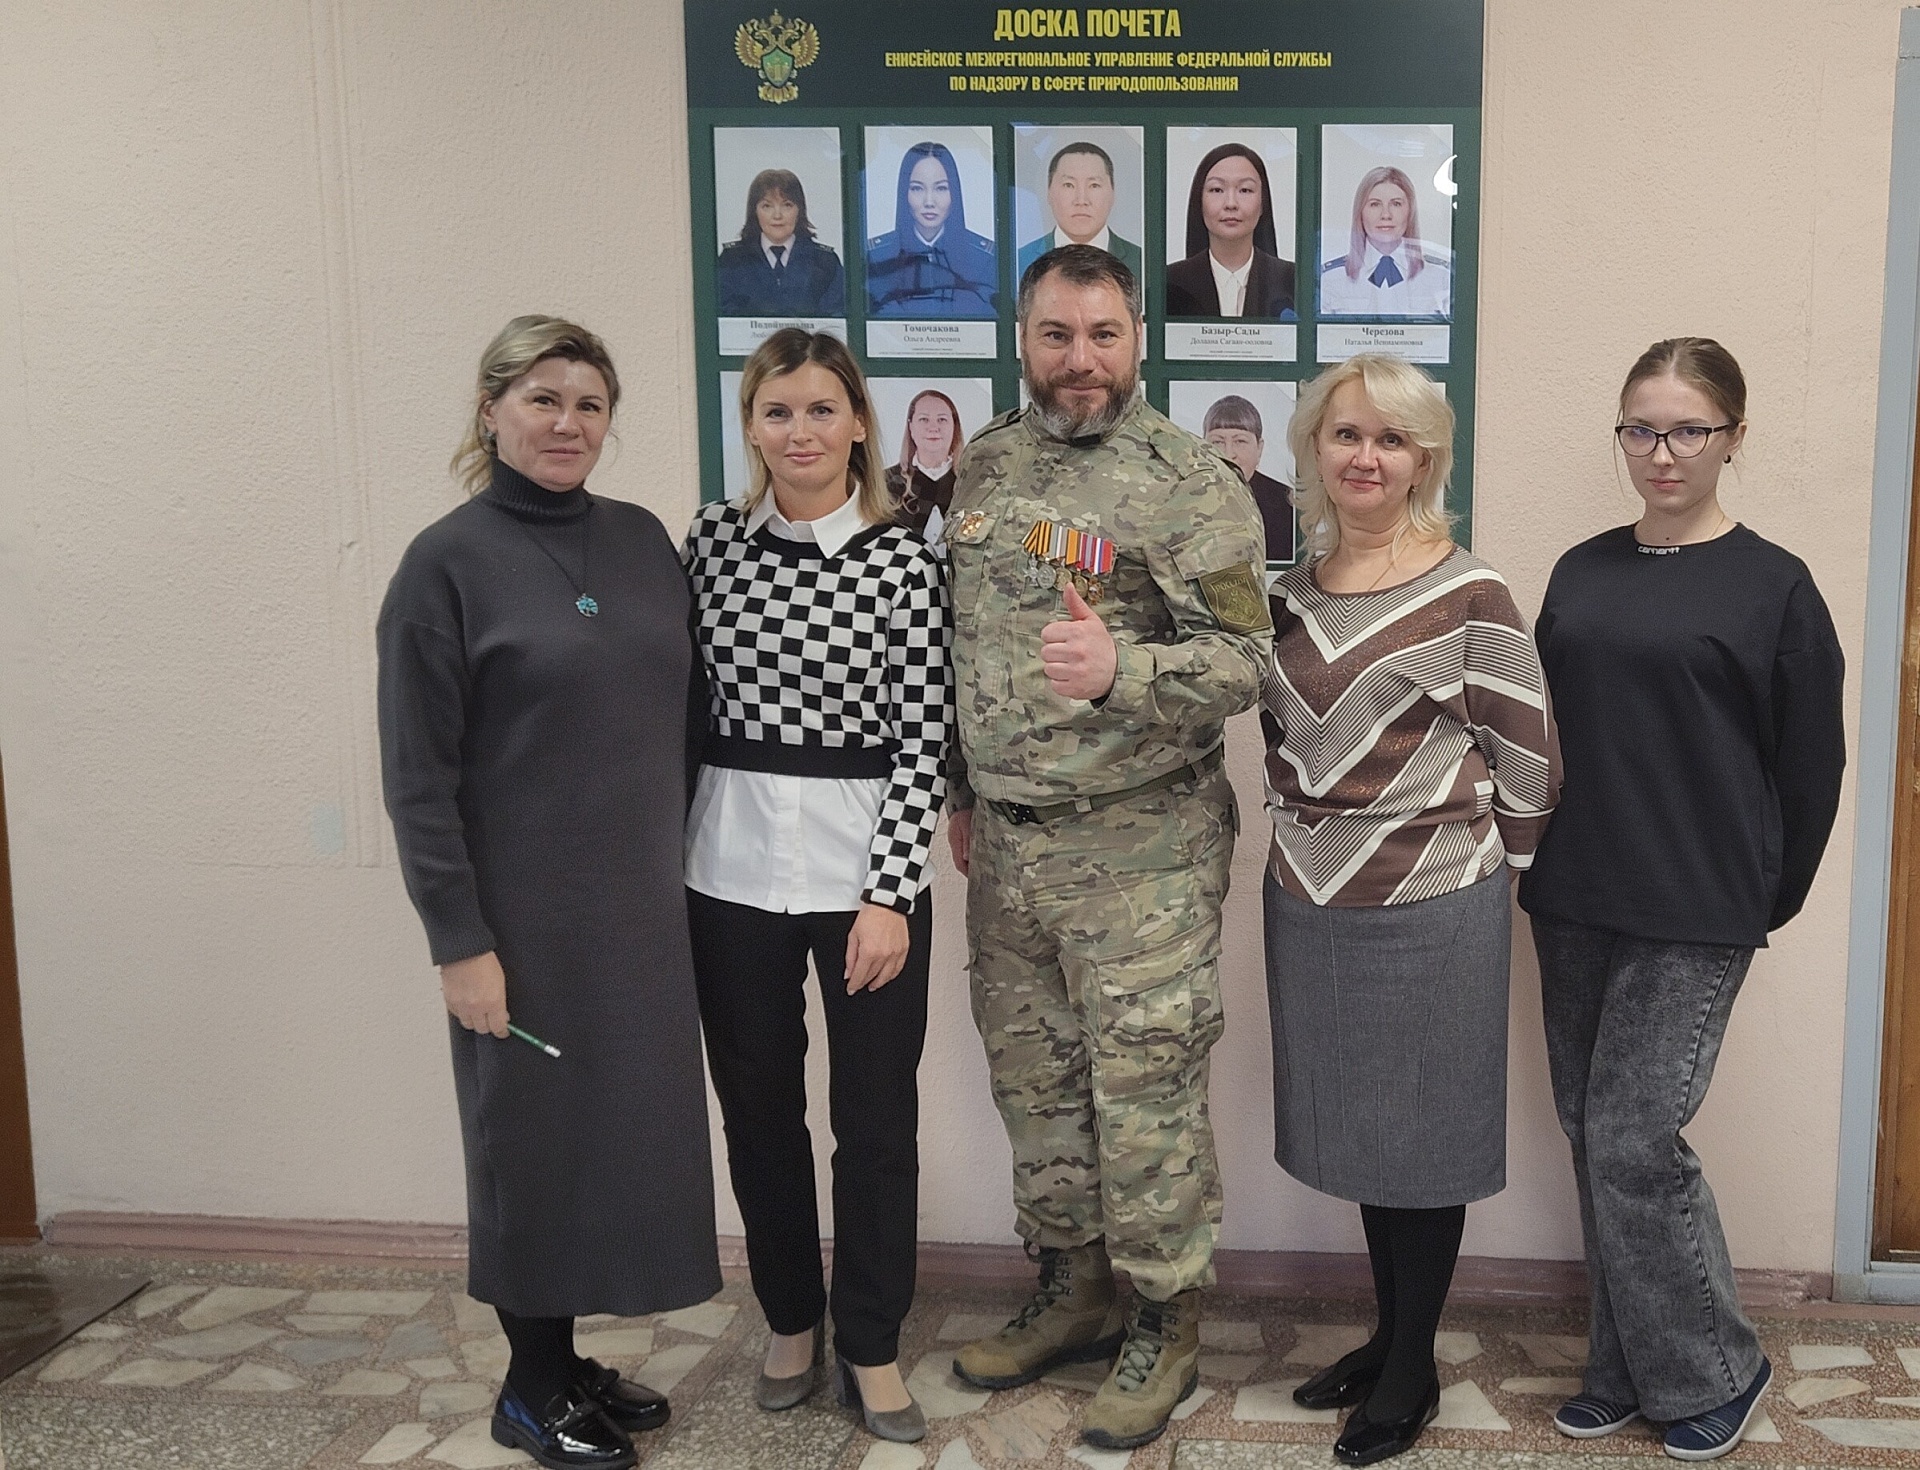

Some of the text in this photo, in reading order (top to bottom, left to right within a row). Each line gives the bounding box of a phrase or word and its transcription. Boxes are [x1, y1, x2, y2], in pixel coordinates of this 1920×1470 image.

[994, 9, 1181, 41] ДОСКА ПОЧЕТА
[885, 49, 1332, 68] ЕНИСЕЙСКОЕ МЕЖРЕГИОНАЛЬНОЕ УПРАВЛЕНИЕ ФЕДЕРАЛЬНОЙ СЛУЖБЫ
[949, 76, 1239, 92] ПО НАДЗОРУ В СФЕРЕ ПРИРОДОПОЛЬЗОВАНИЯ
[903, 324, 959, 333] Томочакова
[1201, 326, 1260, 337] Базыр-Сады
[1362, 327, 1404, 337] Черезова
[903, 335, 961, 343] Ольга Андреевна
[1344, 338, 1372, 346] Наталья
